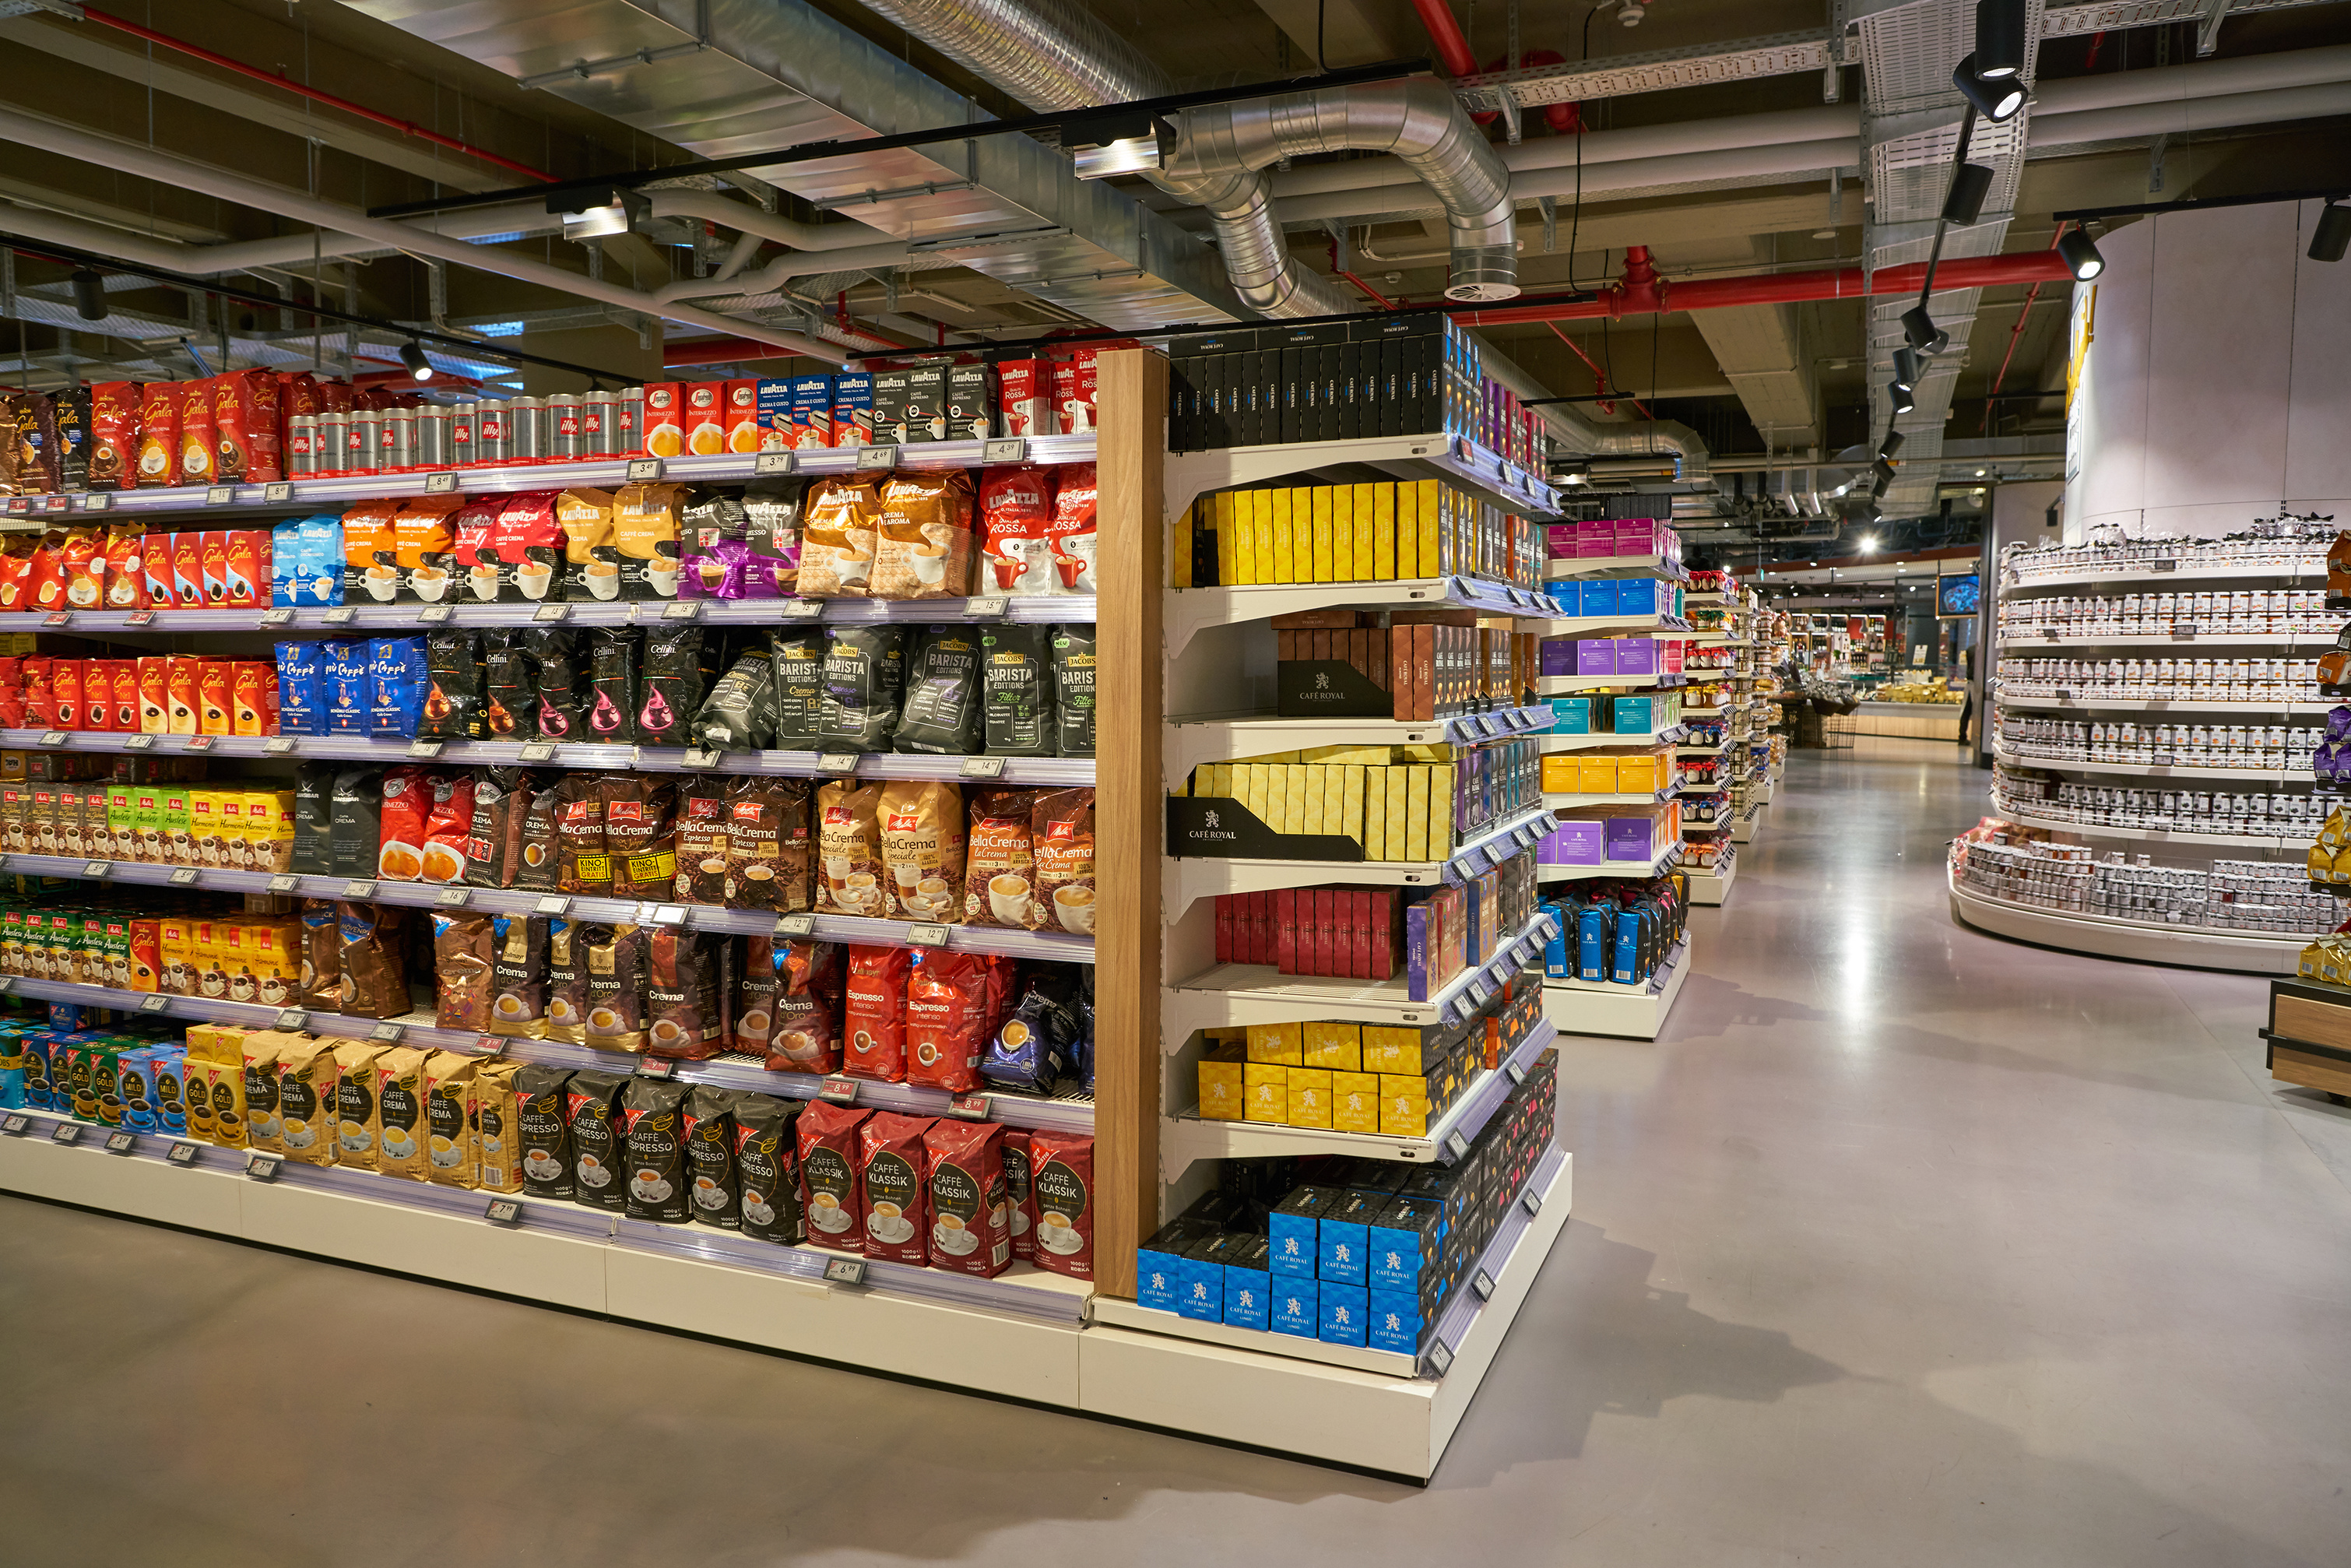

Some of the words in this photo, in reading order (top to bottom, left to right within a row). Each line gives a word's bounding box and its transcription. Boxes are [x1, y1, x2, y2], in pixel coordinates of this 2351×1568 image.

[911, 372, 940, 382] LAVAZZA
[952, 372, 982, 381] LAVAZZA
[1003, 370, 1028, 380] LAVAZZA
[797, 381, 824, 391] LAVAZZA
[839, 378, 868, 388] LAVAZZA
[877, 379, 905, 388] LAVAZZA
[761, 384, 788, 394] LAVAZZA
[216, 392, 239, 417] Gala
[144, 399, 173, 427] Gala
[183, 399, 209, 422] Gala
[989, 489, 1038, 508] LAVAZZA
[561, 506, 599, 520] LAVAZZA
[623, 501, 666, 515] LAVAZZA
[498, 510, 539, 523] LAVAZZA
[991, 524, 1027, 533] ROSSA
[146, 551, 167, 571] Gala
[228, 549, 251, 567] Gala
[940, 641, 969, 650] JACOBS
[787, 649, 814, 659] JACOBS
[835, 647, 856, 656] JACOBS
[929, 654, 972, 669] BARISTA
[995, 653, 1025, 663] JACOBS
[825, 659, 865, 675] BARISTA
[936, 666, 962, 675] EDITIONS
[787, 674, 817, 683] EDITIONS
[829, 672, 856, 682] EDITIONS
[988, 668, 1033, 681] BARISTA
[54, 673, 76, 692] Gala
[202, 673, 225, 693] Gala
[994, 680, 1024, 690] EDITIONS
[789, 686, 815, 695] Crema
[996, 692, 1021, 701] Filter
[525, 821, 550, 830] CREMA
[684, 833, 711, 842] Espresso
[733, 836, 756, 847] Espresso
[970, 835, 1029, 849] BellaCrema
[133, 933, 155, 948] Gala
[497, 965, 528, 978] Crema
[742, 981, 775, 992] Crema
[649, 990, 684, 1001] Crema
[848, 990, 884, 1002] Espresso
[1028, 990, 1057, 1009] Crema
[910, 1001, 949, 1013] Espresso
[72, 1073, 89, 1083] GOLD
[96, 1077, 114, 1087] GOLD
[125, 1084, 142, 1093] MILD
[188, 1088, 206, 1099] GOLD
[339, 1085, 357, 1095] CAFFÈ
[339, 1094, 361, 1105] CREMA
[385, 1091, 404, 1100] CAFFÈ
[383, 1099, 407, 1111] CREMA
[522, 1113, 545, 1124] CAFFÈ
[519, 1123, 559, 1134] ESPRESSO
[634, 1133, 659, 1142] CAFFÈ
[629, 1141, 673, 1152] ESPRESSO
[811, 1156, 838, 1167] CAFFÈ
[808, 1166, 844, 1180] KLASSIK
[873, 1162, 899, 1175] CAFFÈ
[868, 1173, 908, 1187] KLASSIK
[1043, 1172, 1069, 1185] CAFFÈ
[1038, 1181, 1077, 1199] KLASSIK
